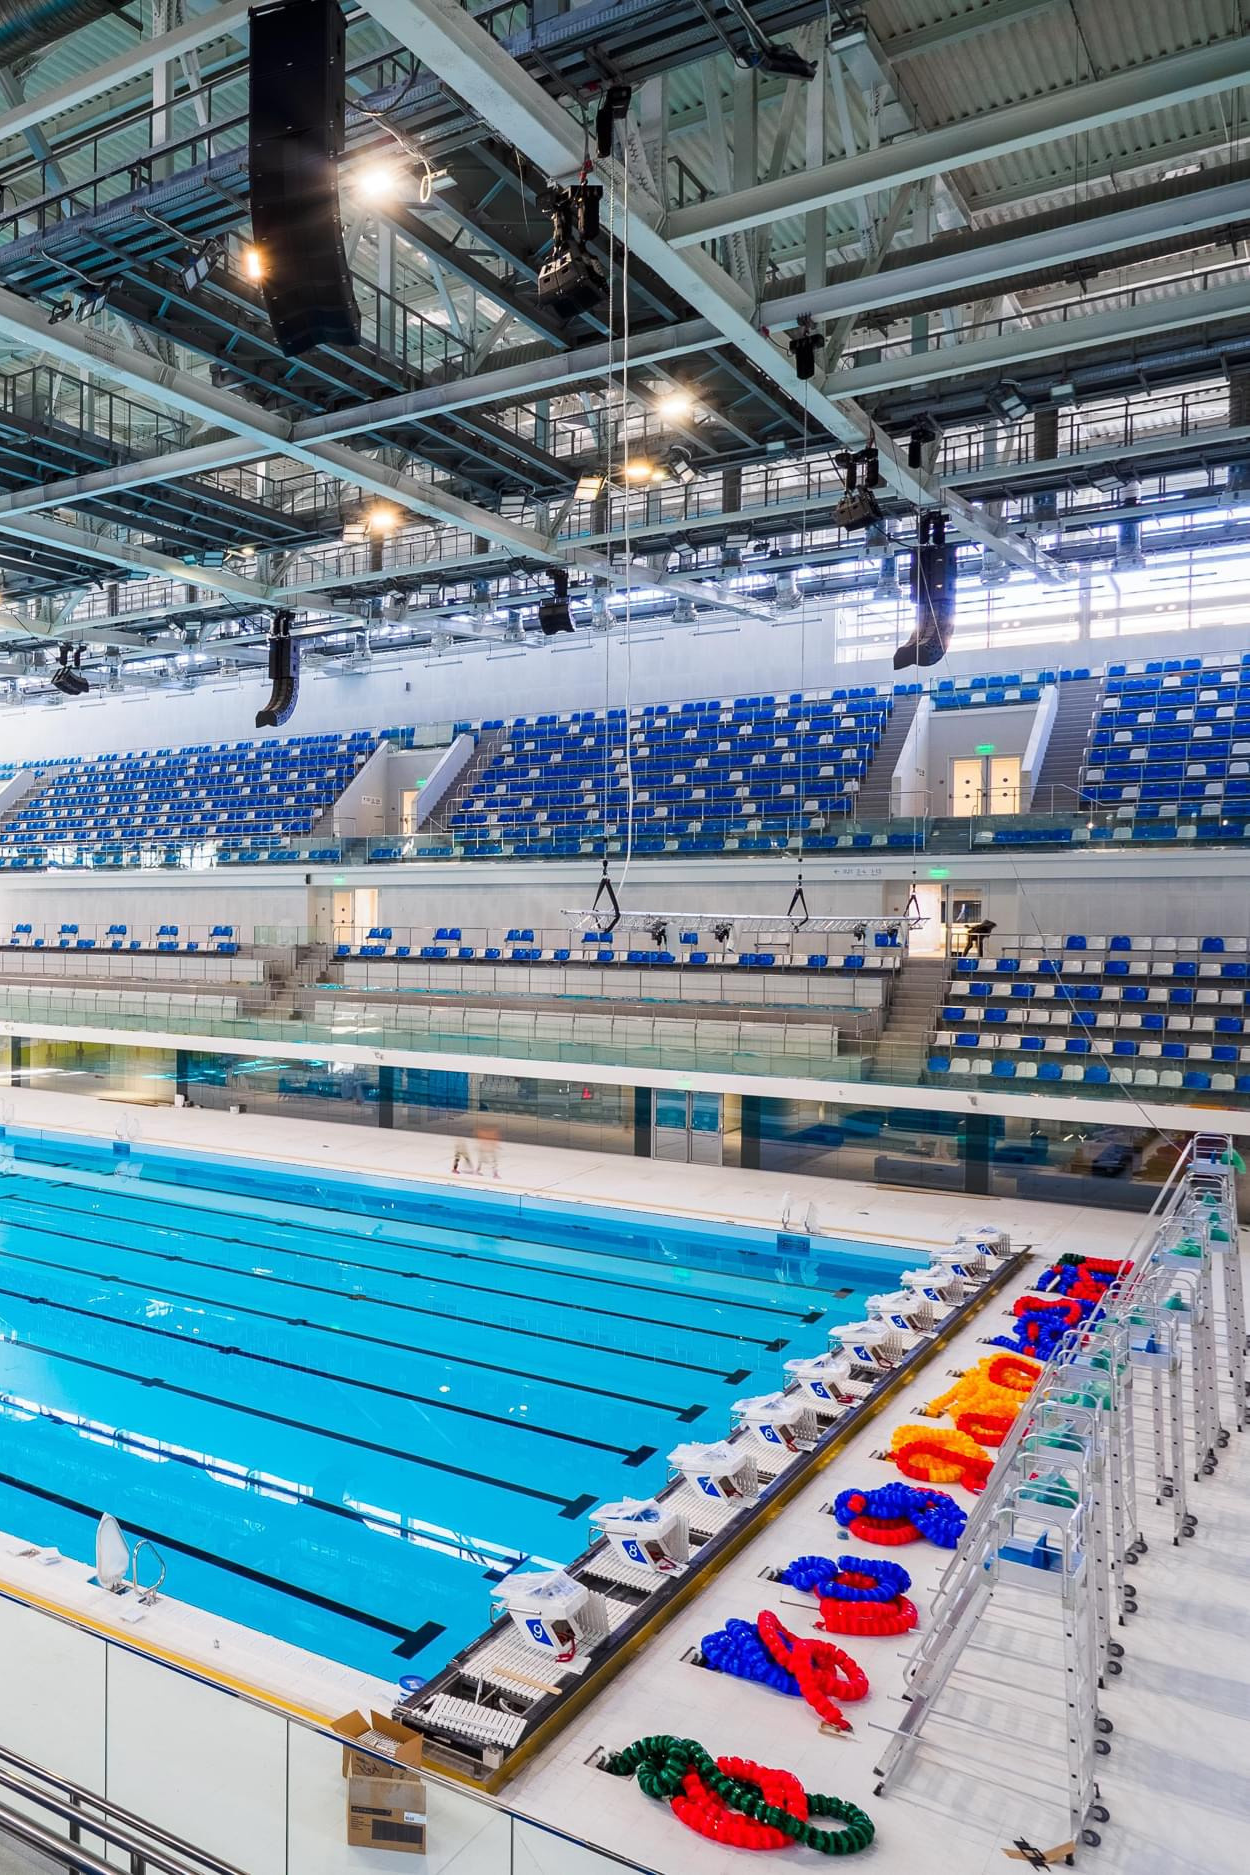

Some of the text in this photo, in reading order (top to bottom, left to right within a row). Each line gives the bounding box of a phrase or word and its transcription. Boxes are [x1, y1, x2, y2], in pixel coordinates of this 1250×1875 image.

[928, 1290, 935, 1299] 2
[895, 1317, 902, 1326] 3
[858, 1350, 865, 1358] 4
[816, 1385, 823, 1395] 5
[765, 1428, 773, 1439] 6
[704, 1478, 712, 1491] 7
[629, 1544, 637, 1557] 8
[533, 1624, 543, 1639] 9
